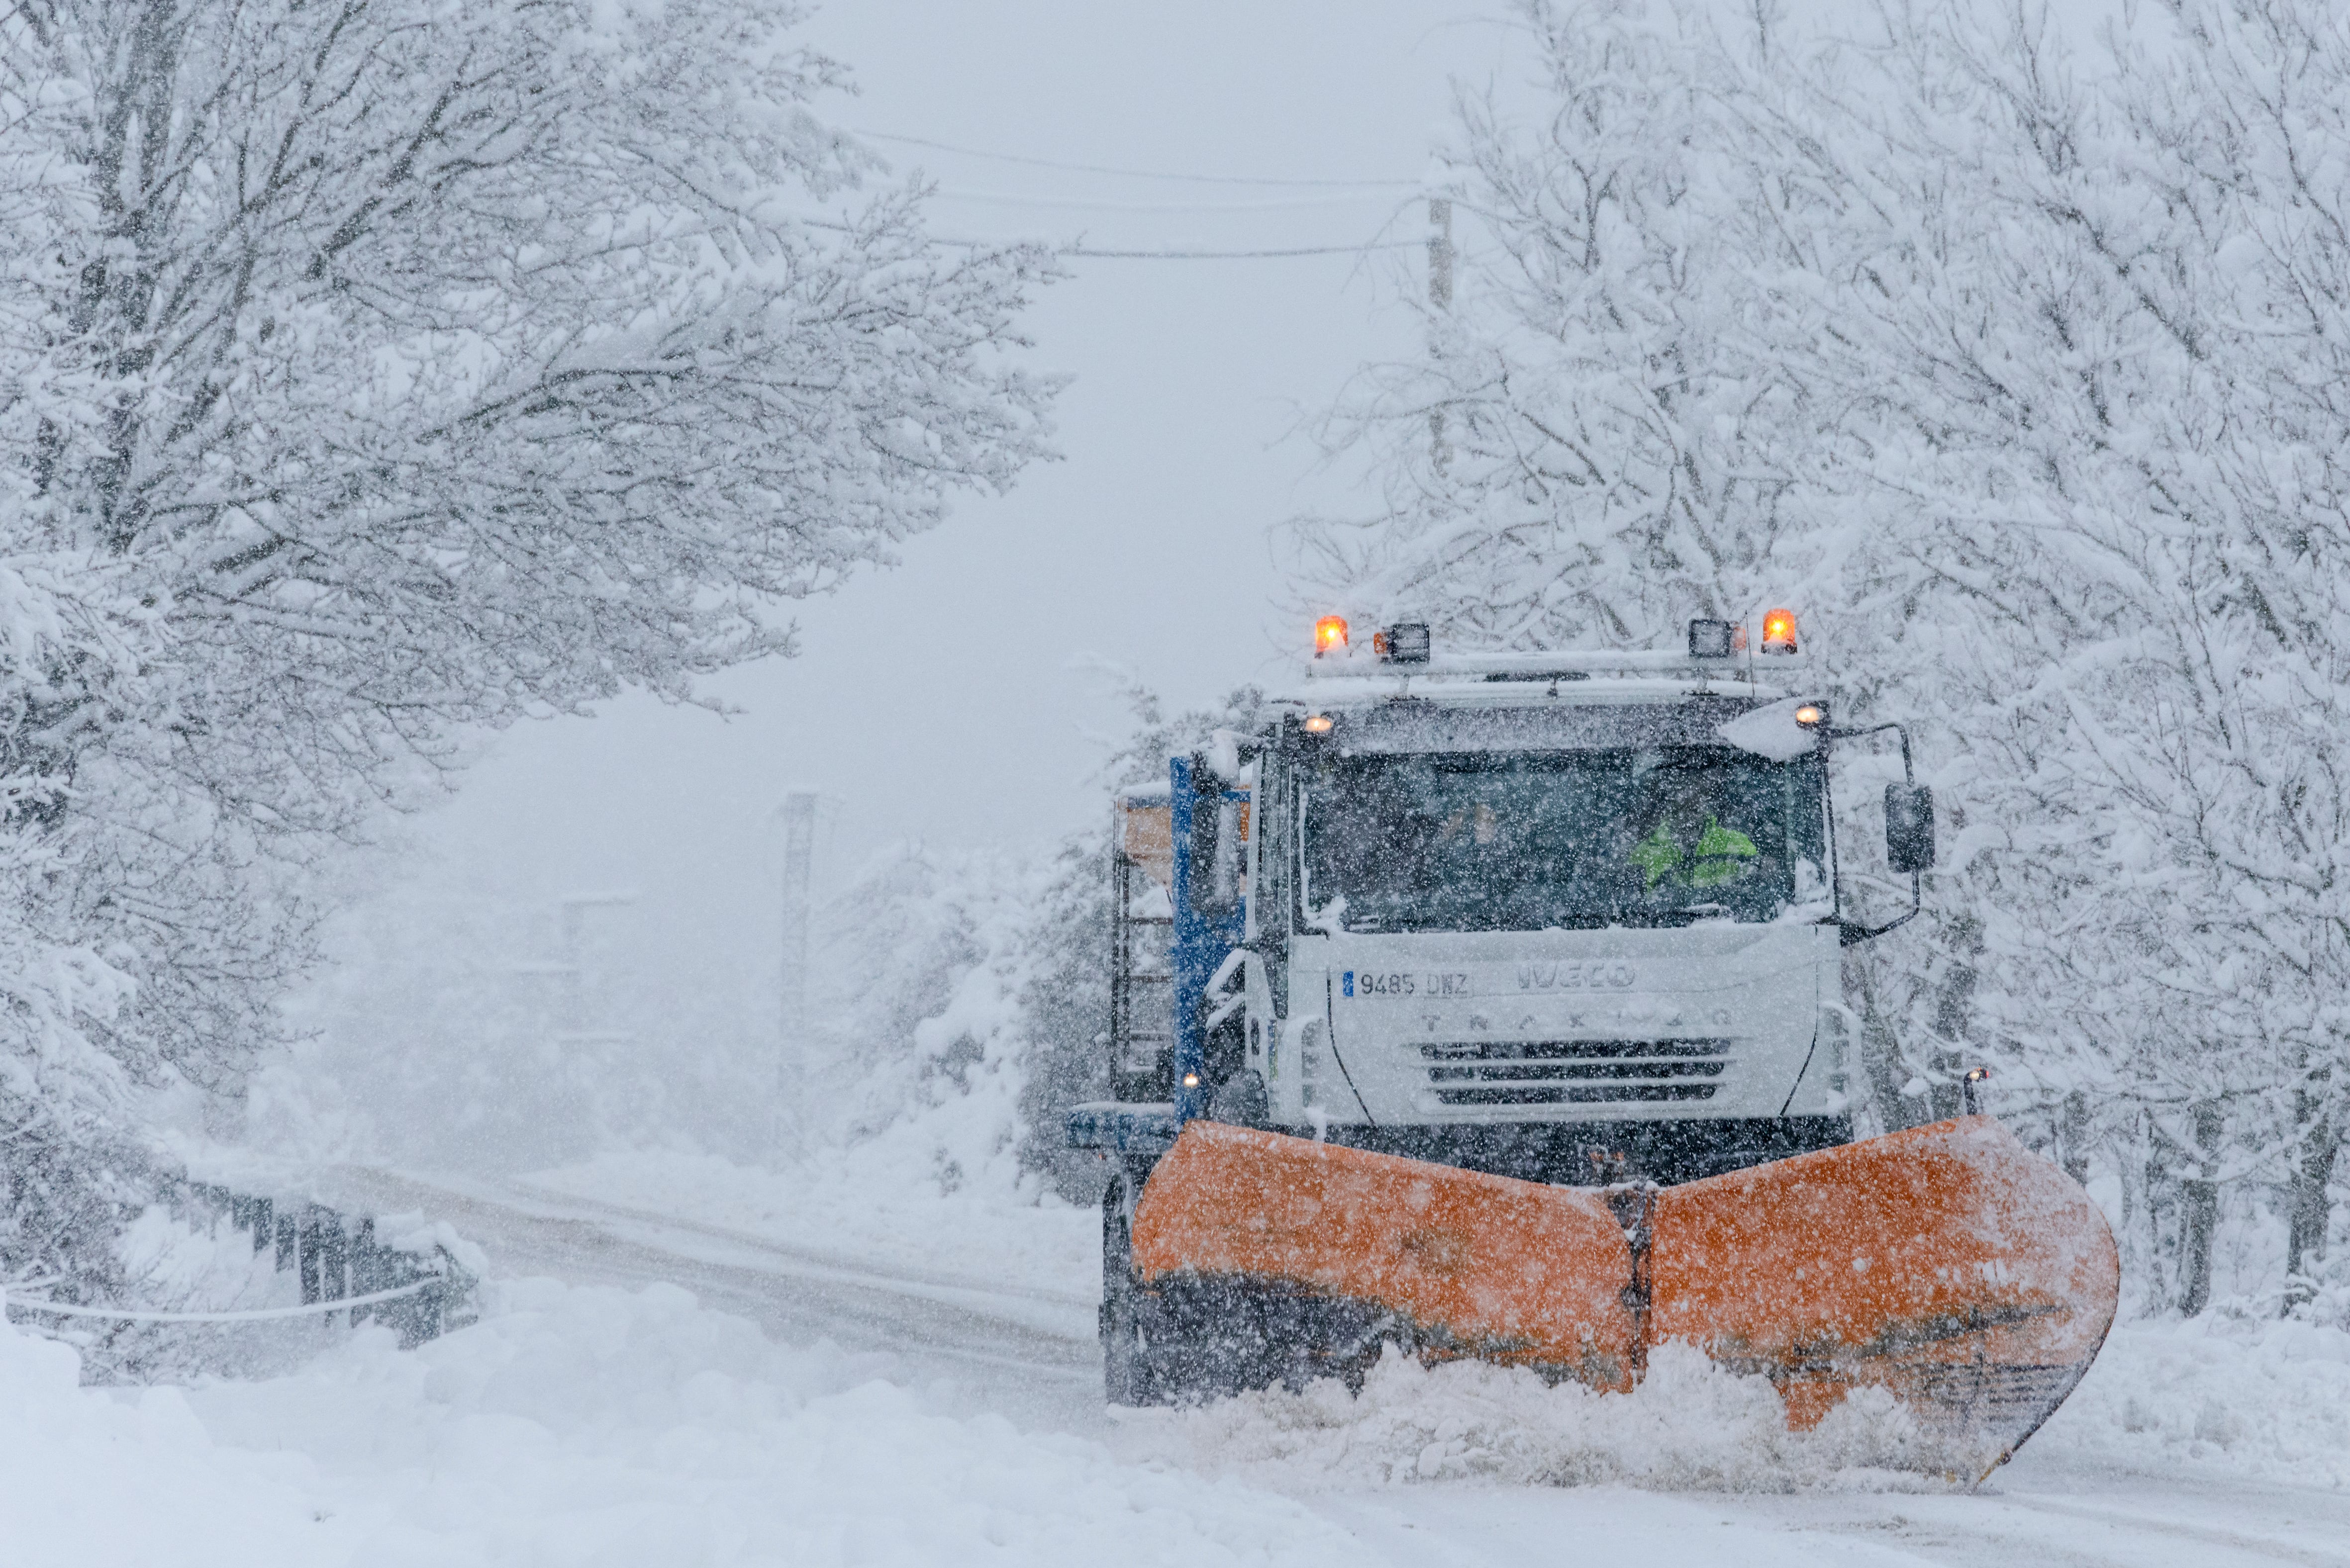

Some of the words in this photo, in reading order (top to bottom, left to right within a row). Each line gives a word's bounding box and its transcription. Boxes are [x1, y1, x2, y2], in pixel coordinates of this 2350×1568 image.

[1361, 974, 1415, 995] 9485
[1518, 963, 1636, 989] IVECO
[1421, 1010, 1732, 1031] TRAKR
